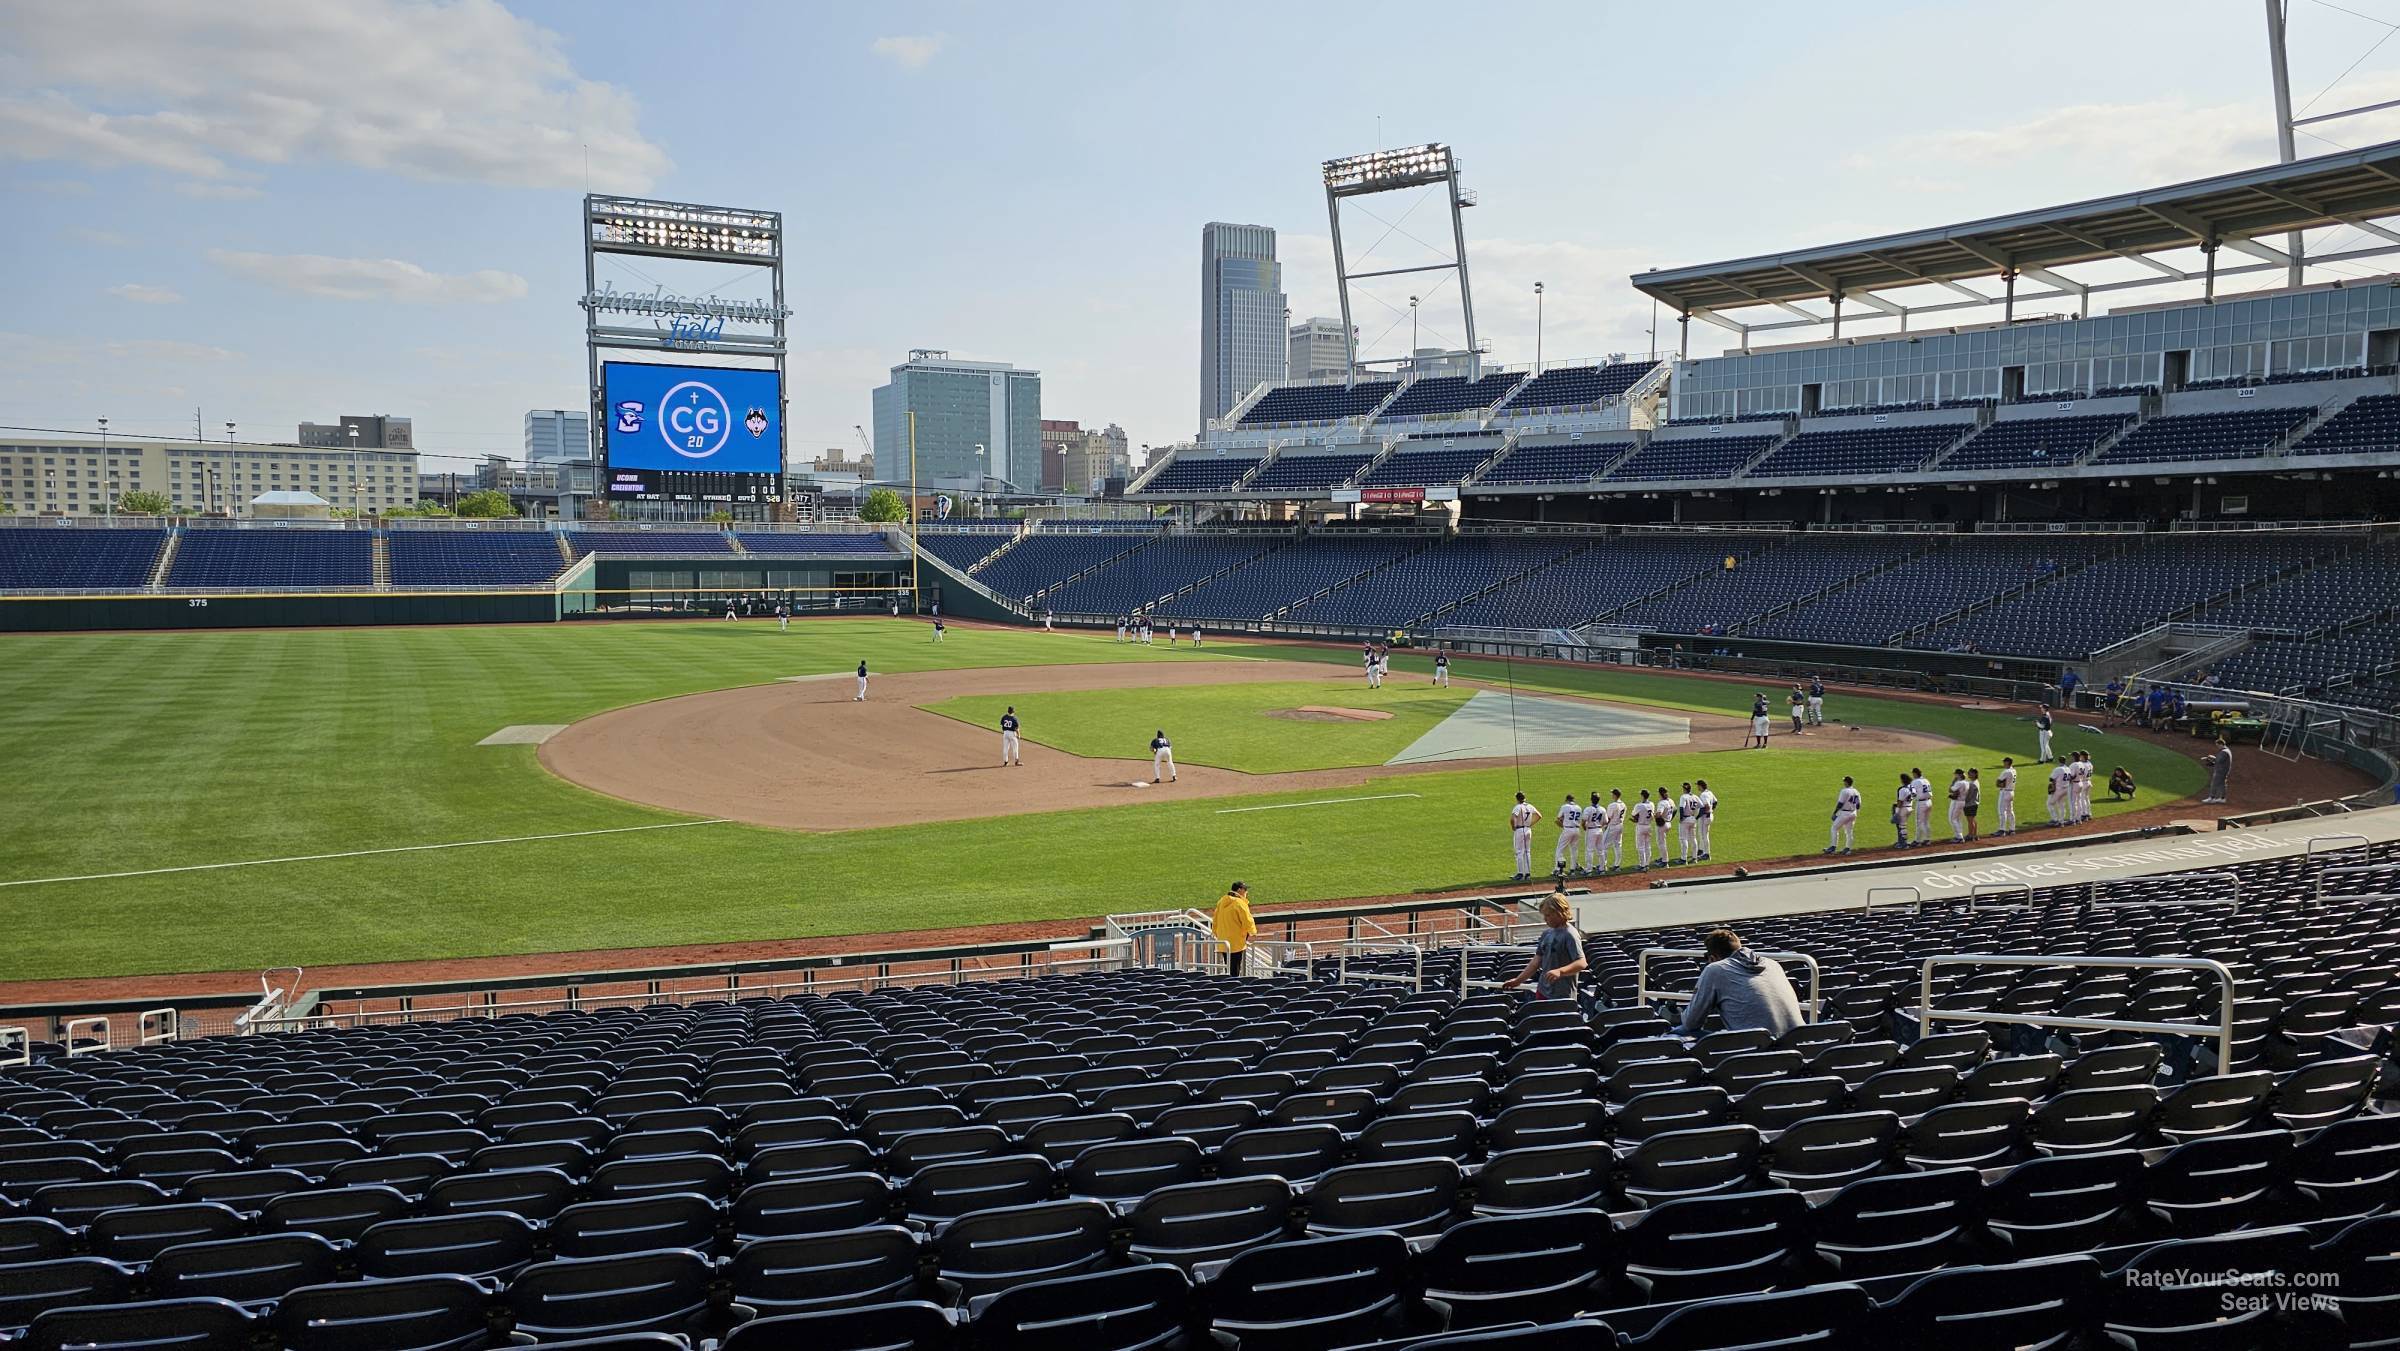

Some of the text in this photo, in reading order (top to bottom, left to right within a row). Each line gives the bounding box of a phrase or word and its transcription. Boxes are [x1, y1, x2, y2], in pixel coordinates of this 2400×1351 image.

[586, 280, 790, 320] charles SCHWAB
[662, 315, 726, 347] field
[675, 339, 719, 351] OMAHA
[671, 406, 720, 435] CG
[687, 436, 704, 448] 20
[616, 474, 639, 482] UCONN
[611, 484, 645, 492] CREIGHTON
[188, 598, 209, 608] 375
[1003, 719, 1013, 728] 20
[1524, 811, 1531, 821] 7
[1568, 810, 1581, 821] 32
[1591, 812, 1603, 822] 24
[1922, 859, 2070, 890] charles
[2190, 832, 2283, 859] field
